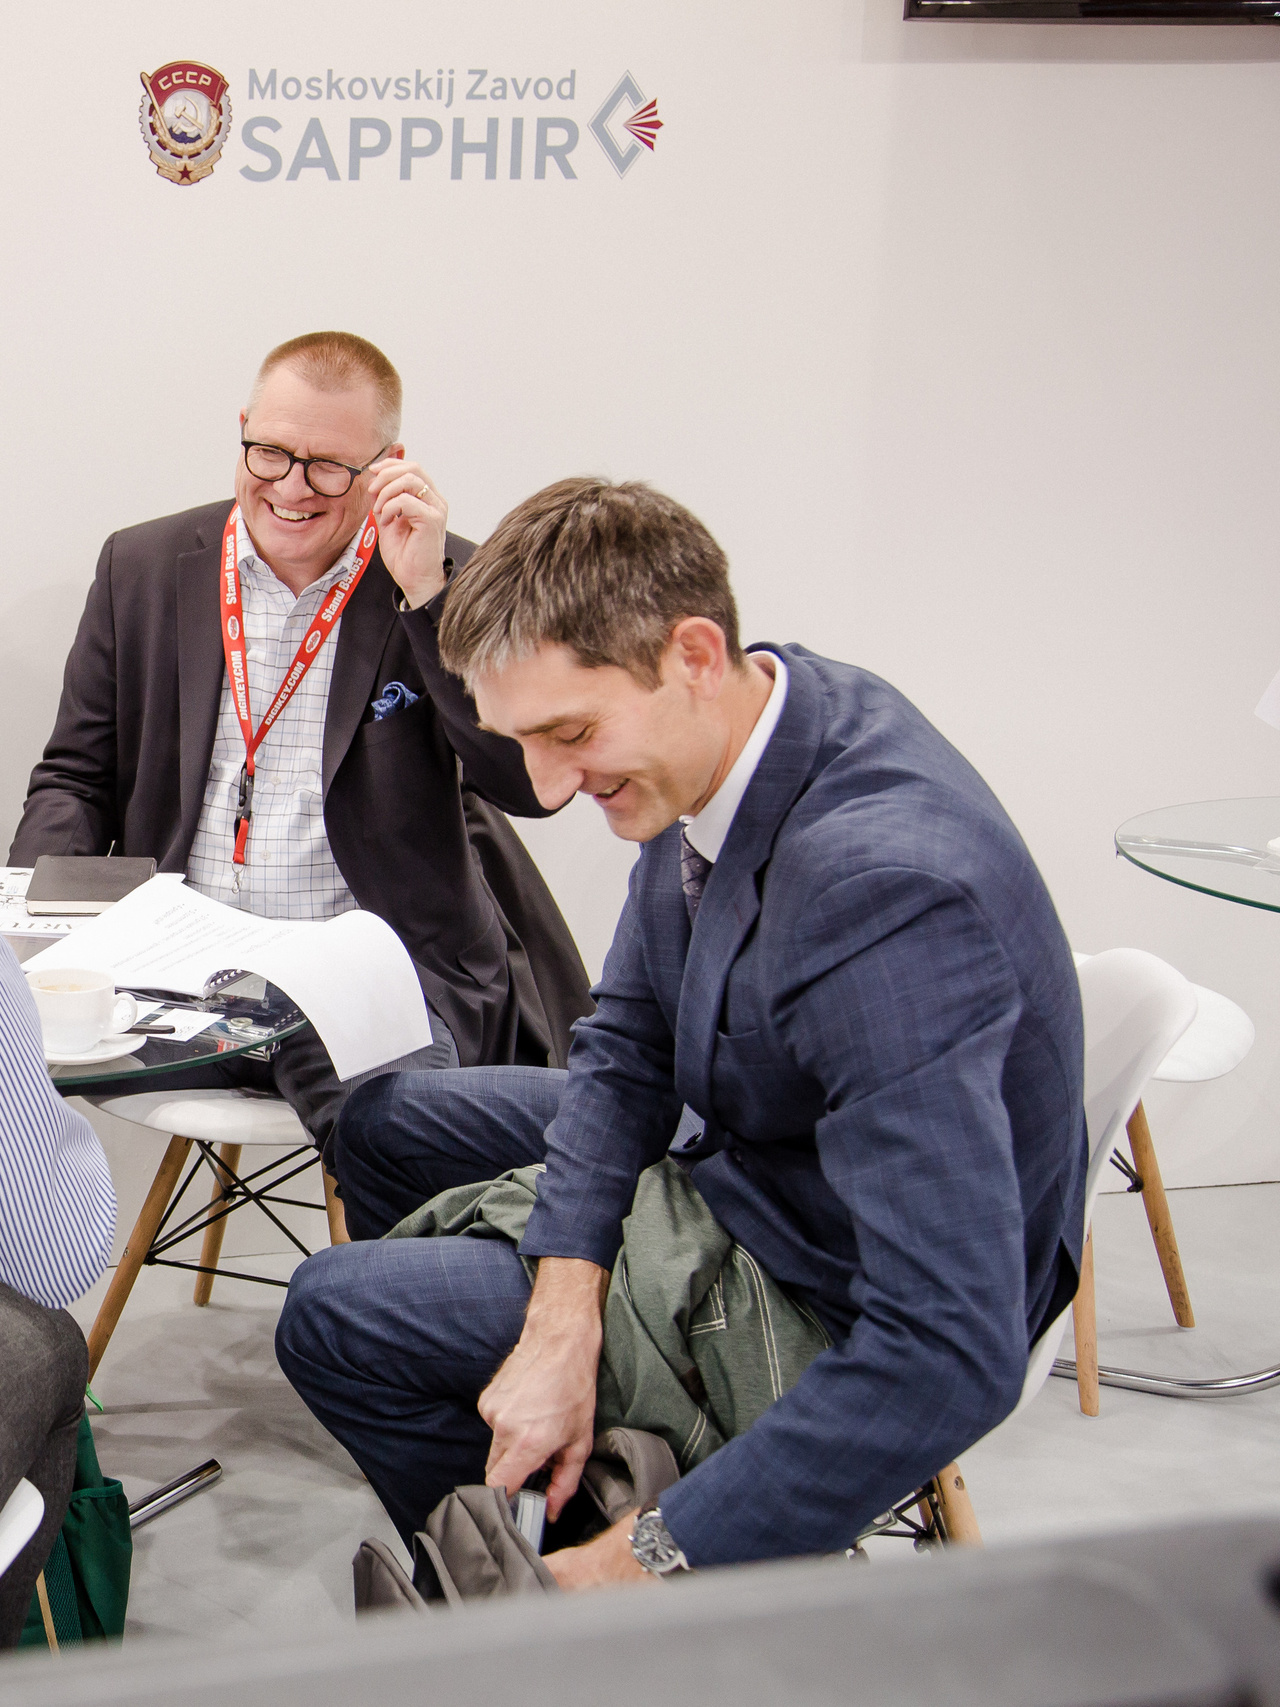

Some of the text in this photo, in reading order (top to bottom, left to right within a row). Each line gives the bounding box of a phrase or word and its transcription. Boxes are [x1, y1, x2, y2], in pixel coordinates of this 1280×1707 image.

[247, 68, 577, 109] Moskovskij Zavod
[238, 115, 581, 183] SAPPHIR
[224, 533, 236, 571] B5.165
[225, 571, 238, 606] Stand
[321, 555, 365, 623] Stand B5.165
[230, 650, 249, 721] DIGIKEY.COM
[264, 660, 306, 726] DIGIKEY.COM
